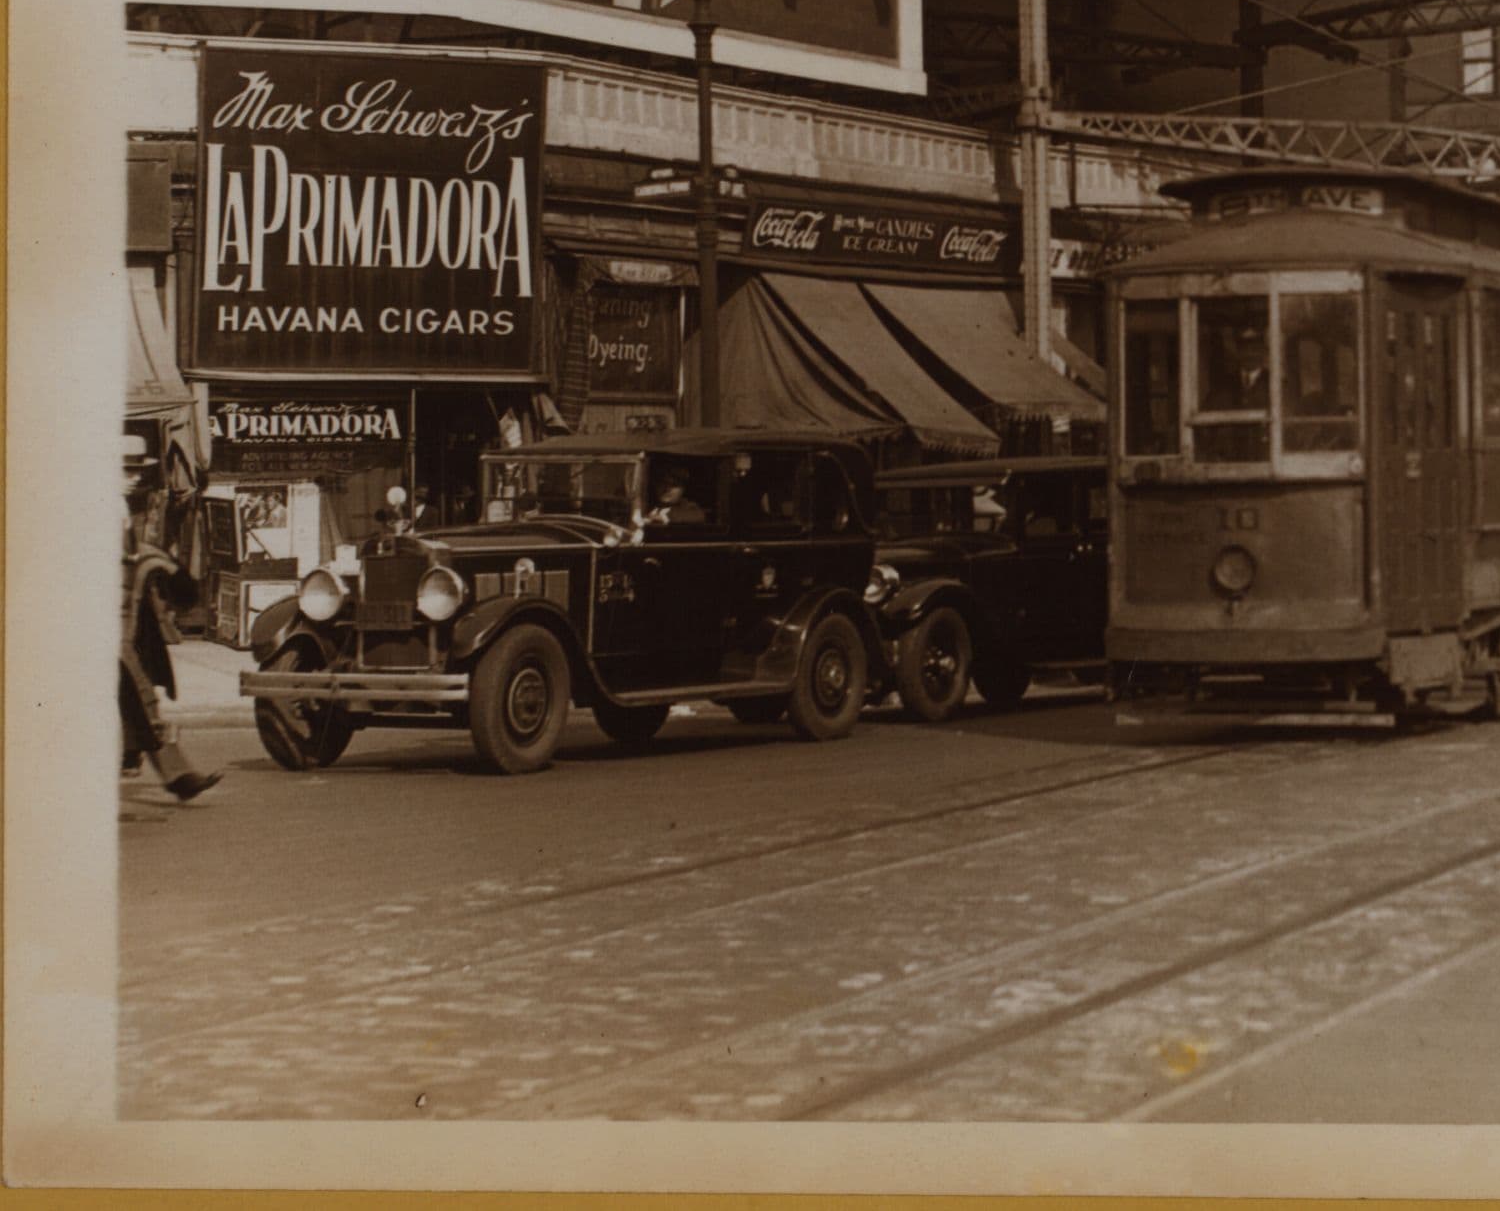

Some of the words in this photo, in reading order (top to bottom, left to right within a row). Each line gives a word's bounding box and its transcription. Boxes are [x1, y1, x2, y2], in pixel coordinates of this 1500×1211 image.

[212, 69, 312, 134] Max
[320, 79, 534, 174] Schwarz's
[1304, 187, 1372, 211] AVE
[203, 143, 251, 292] LA
[248, 143, 533, 298] PRIMADORA
[875, 217, 936, 240] CANDIES
[842, 234, 862, 251] ICE
[866, 235, 919, 256] CREAM
[217, 305, 364, 333] HAVANA
[378, 308, 515, 335] CIGARS
[226, 407, 402, 440] PRIMADORA
